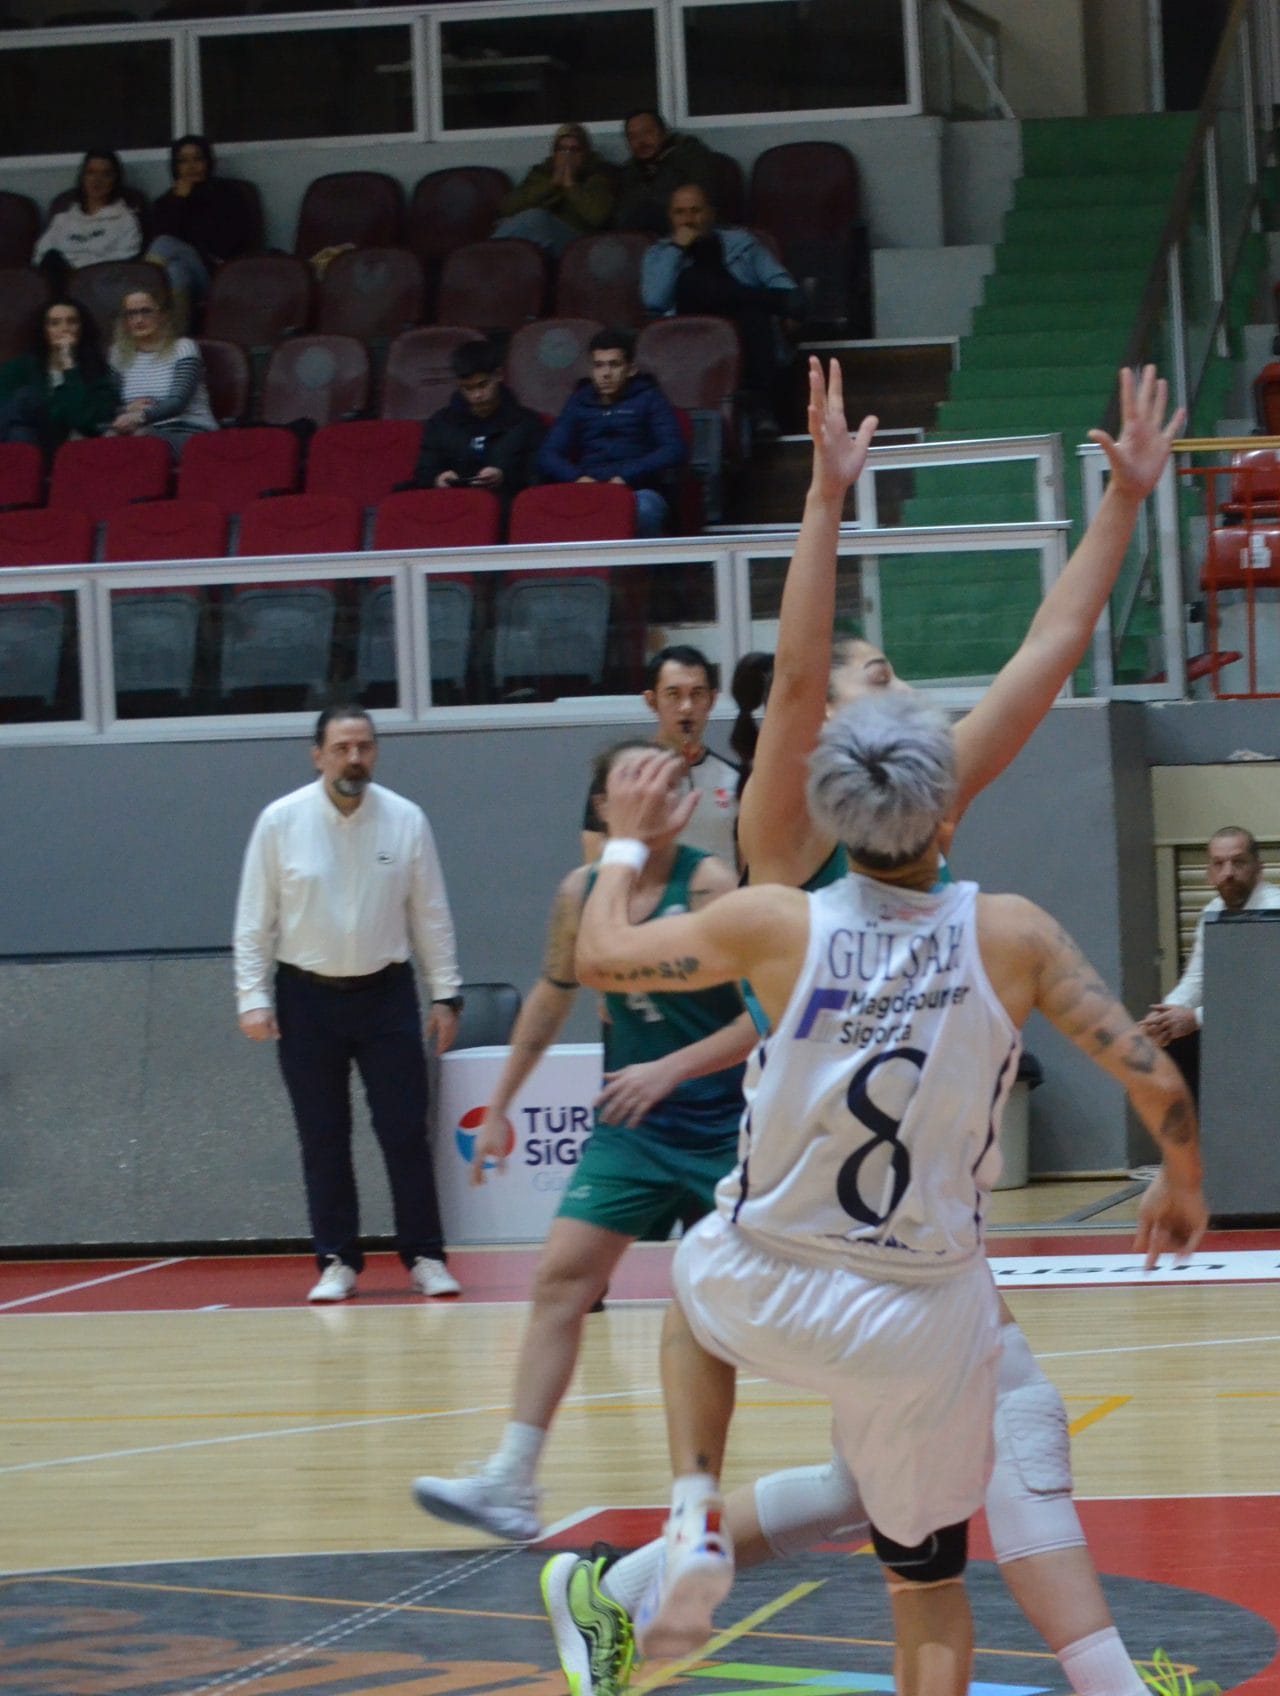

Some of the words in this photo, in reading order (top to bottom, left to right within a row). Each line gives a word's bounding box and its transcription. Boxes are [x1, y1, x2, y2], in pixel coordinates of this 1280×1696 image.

[522, 1106, 593, 1133] TÜR
[525, 1136, 591, 1166] SİG
[836, 1047, 928, 1226] 8
